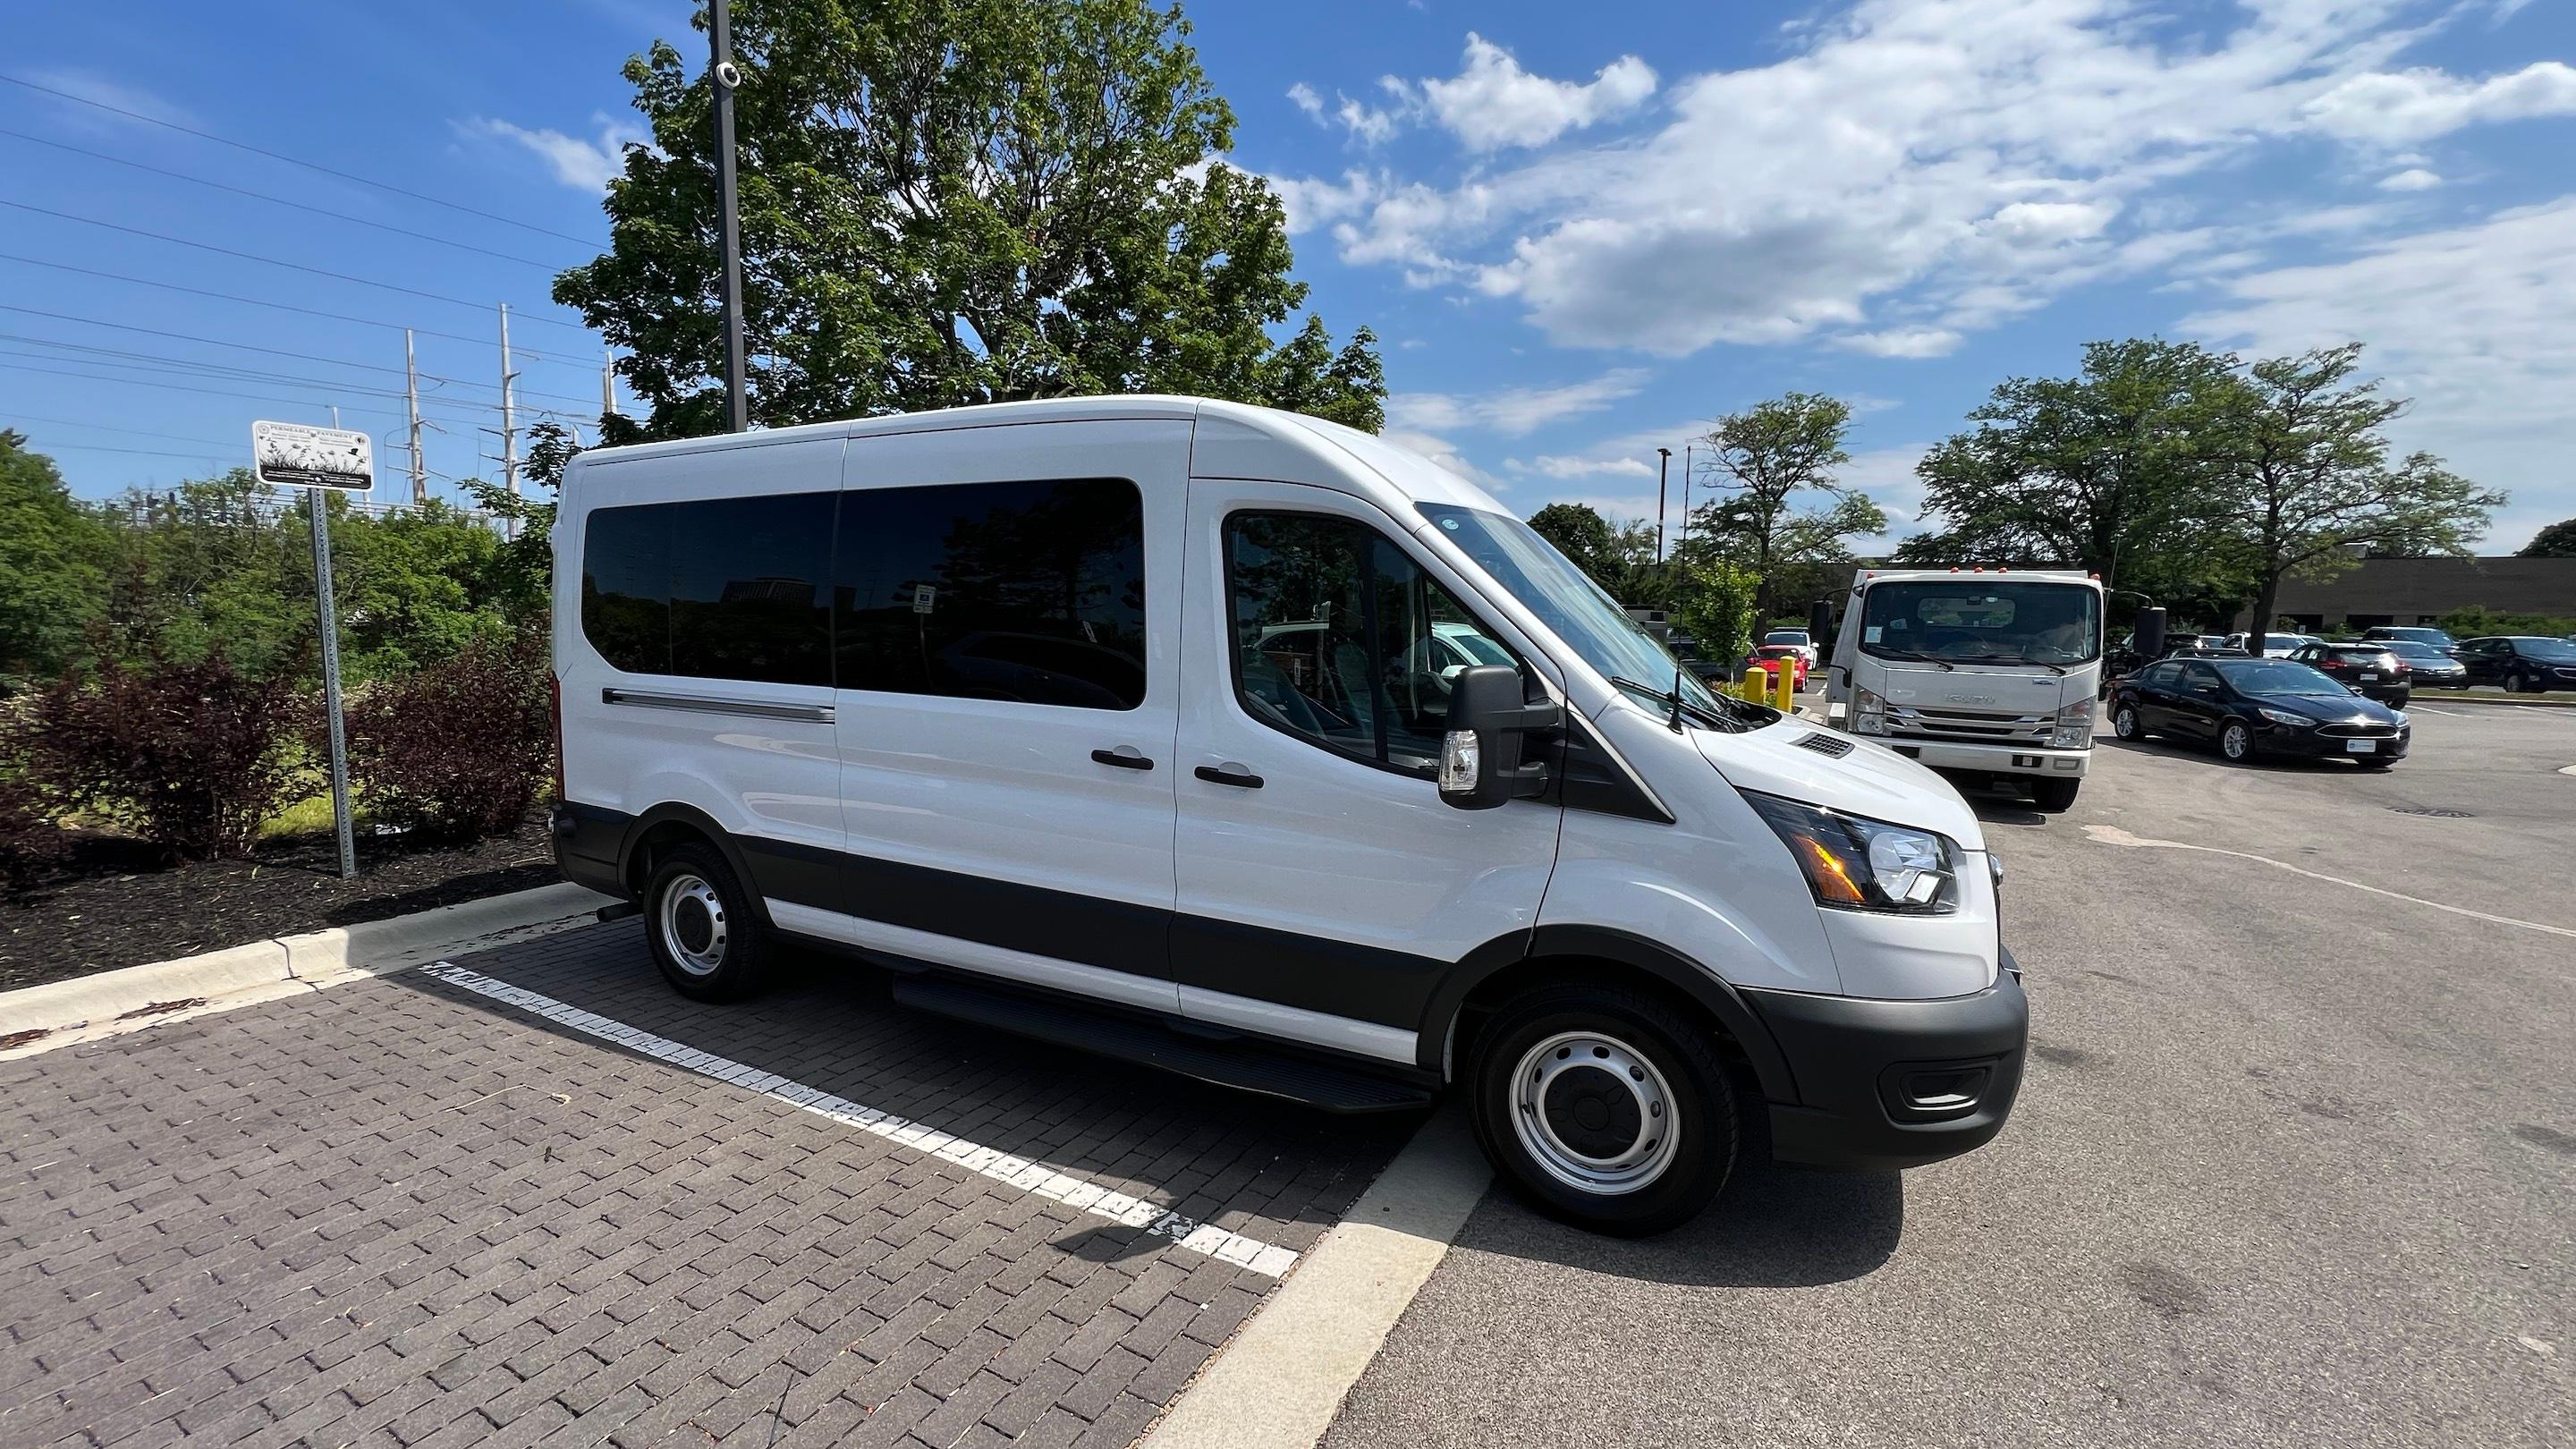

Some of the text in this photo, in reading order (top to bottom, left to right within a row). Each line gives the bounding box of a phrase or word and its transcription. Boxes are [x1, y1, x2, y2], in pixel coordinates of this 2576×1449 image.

[270, 425, 310, 434] PERMEABLE
[317, 431, 352, 439] PAVEMENT
[1945, 693, 1996, 705] ISUZU
